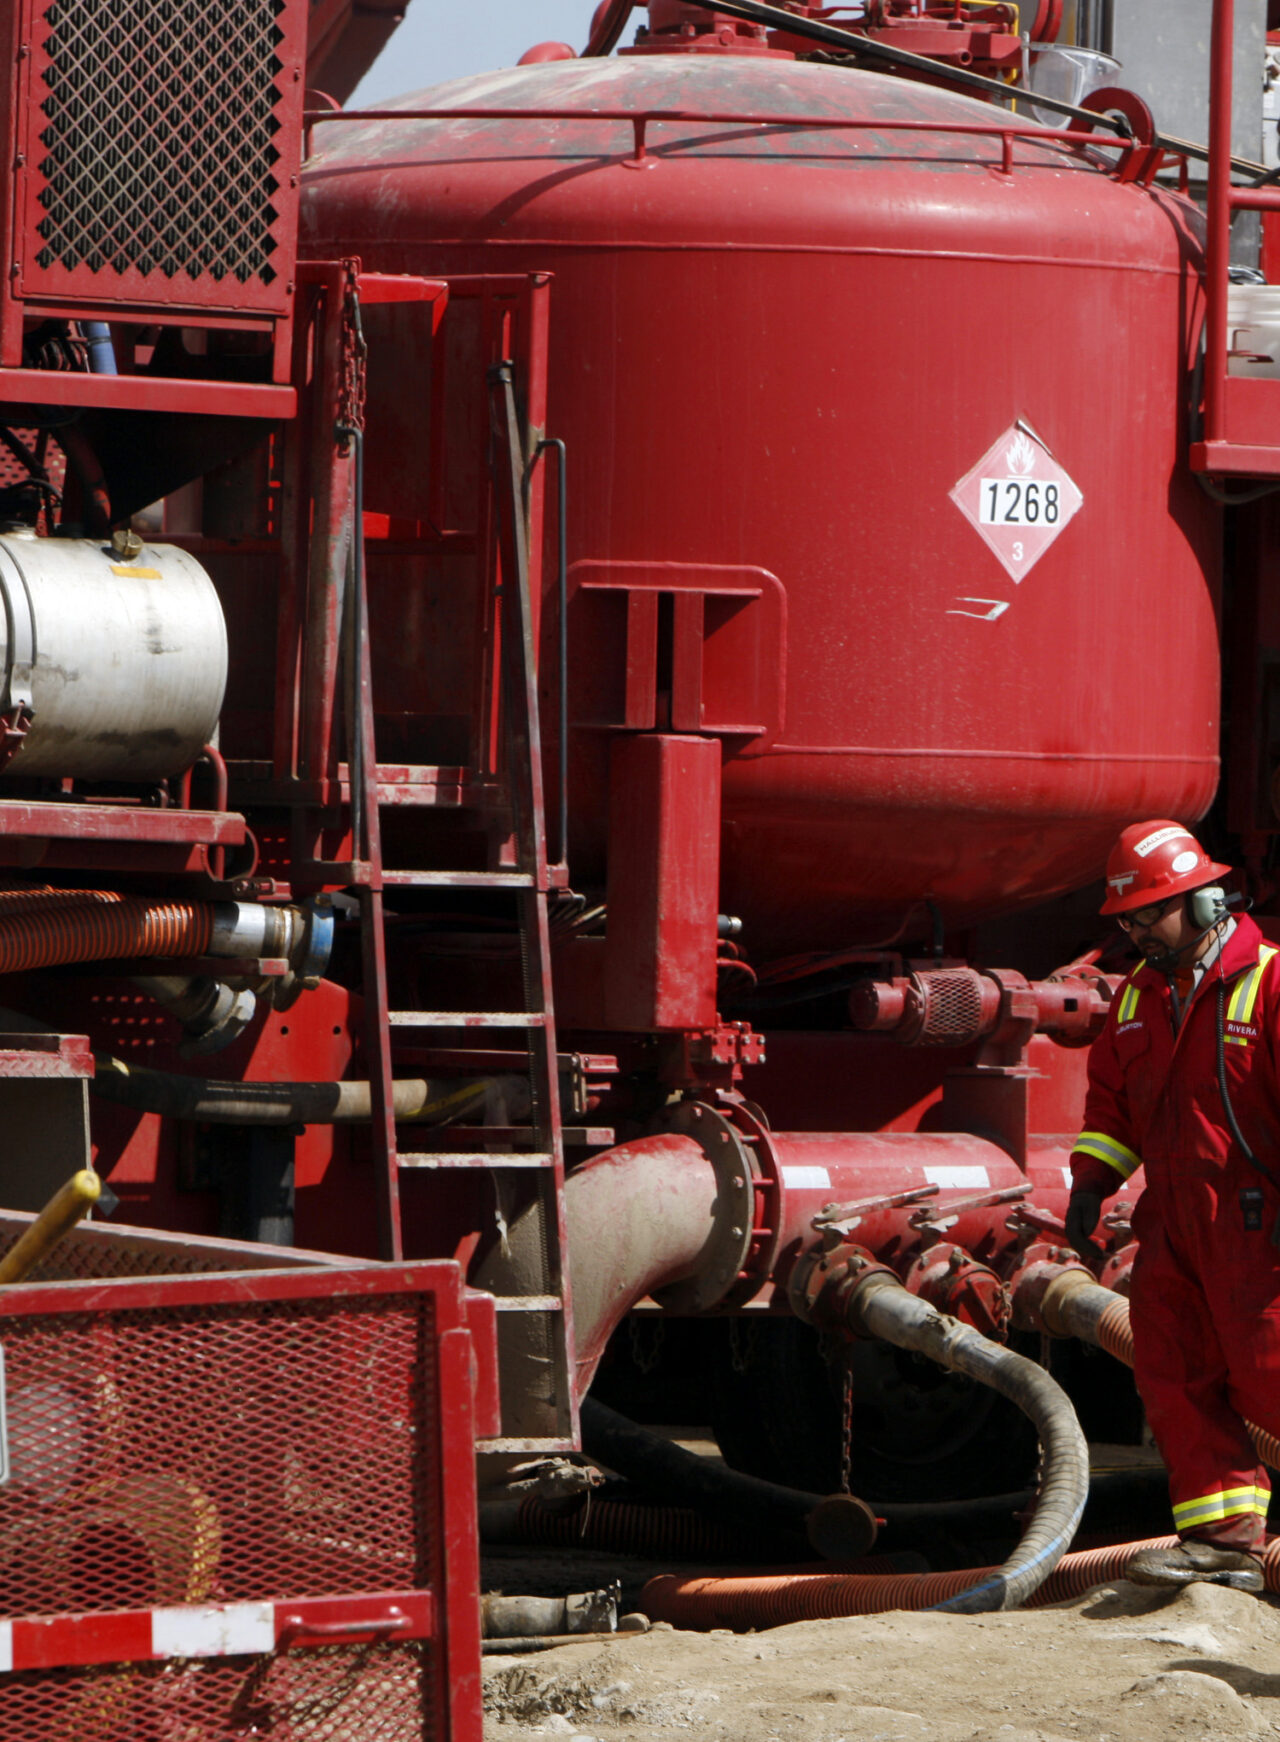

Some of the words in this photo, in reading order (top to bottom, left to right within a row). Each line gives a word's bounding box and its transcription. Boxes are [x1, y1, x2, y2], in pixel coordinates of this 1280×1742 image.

[988, 483, 1059, 524] 1268
[1012, 541, 1024, 562] 3
[1227, 1023, 1257, 1036] RIVERA
